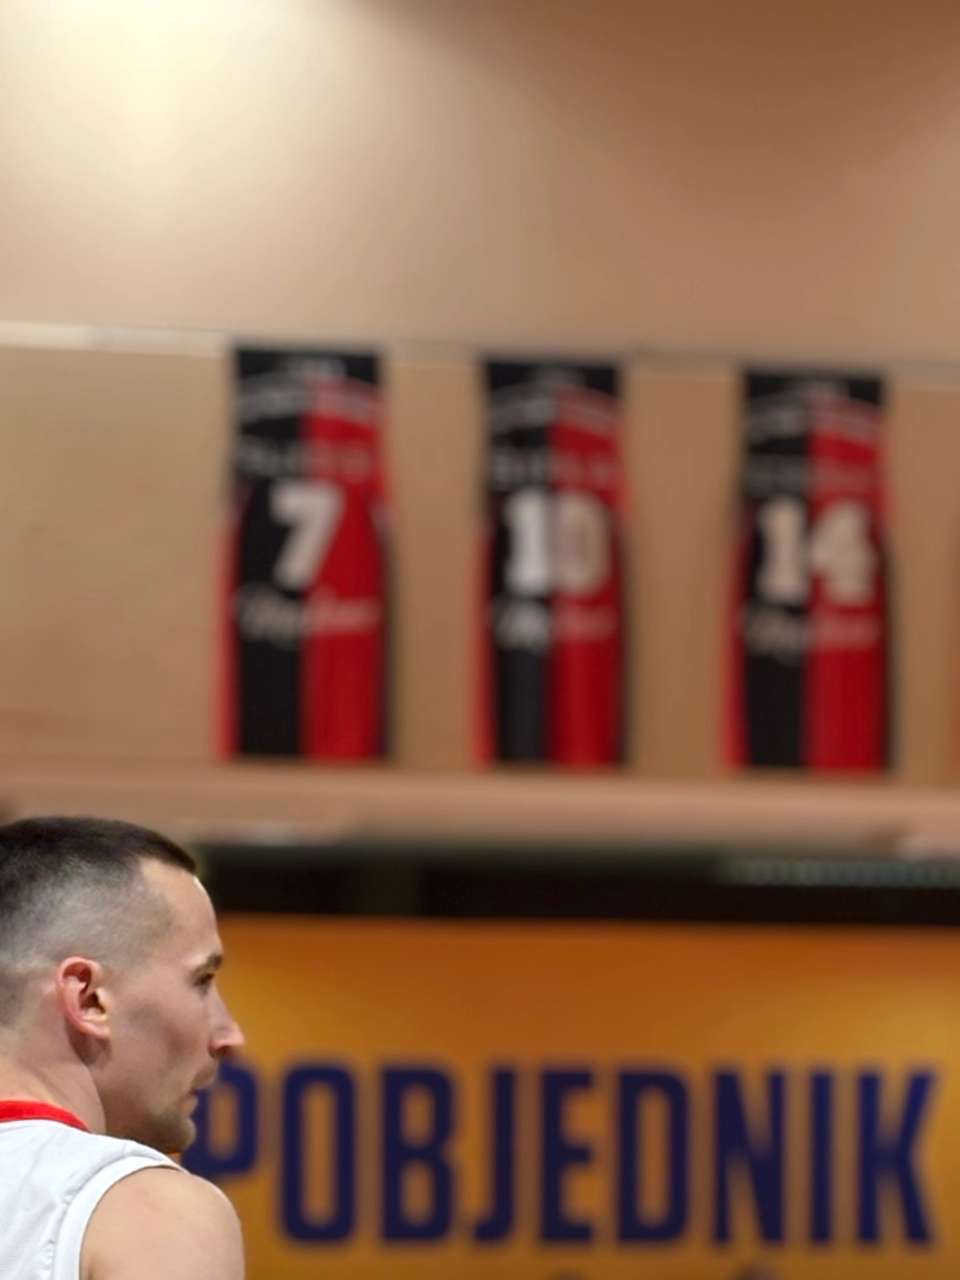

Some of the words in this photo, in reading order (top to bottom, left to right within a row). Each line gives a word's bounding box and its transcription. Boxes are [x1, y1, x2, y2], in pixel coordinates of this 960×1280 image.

[270, 483, 344, 588] 7
[506, 492, 611, 596] 10
[757, 502, 877, 604] 14
